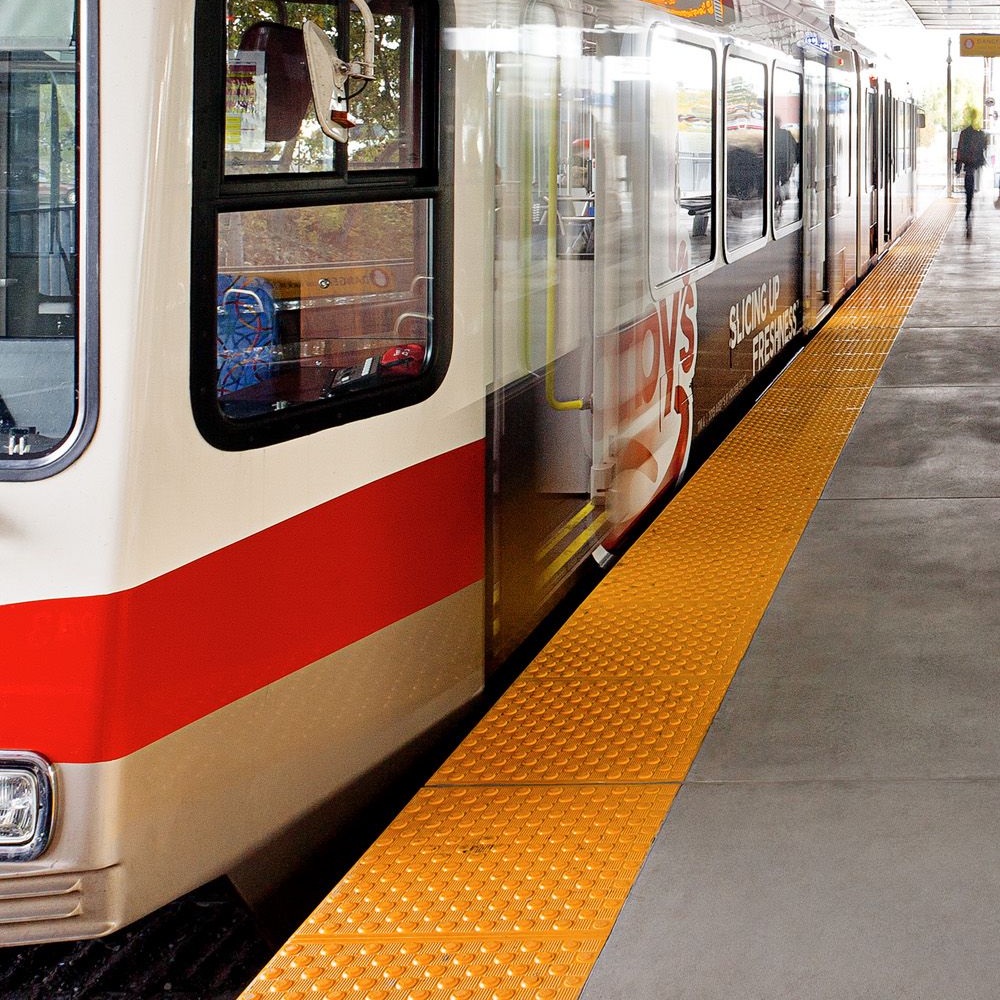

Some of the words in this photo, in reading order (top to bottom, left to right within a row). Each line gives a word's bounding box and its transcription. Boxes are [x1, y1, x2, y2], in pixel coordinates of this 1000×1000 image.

[728, 282, 767, 350] SLICING
[768, 274, 780, 315] UP
[752, 302, 798, 377] FRESHNESS
